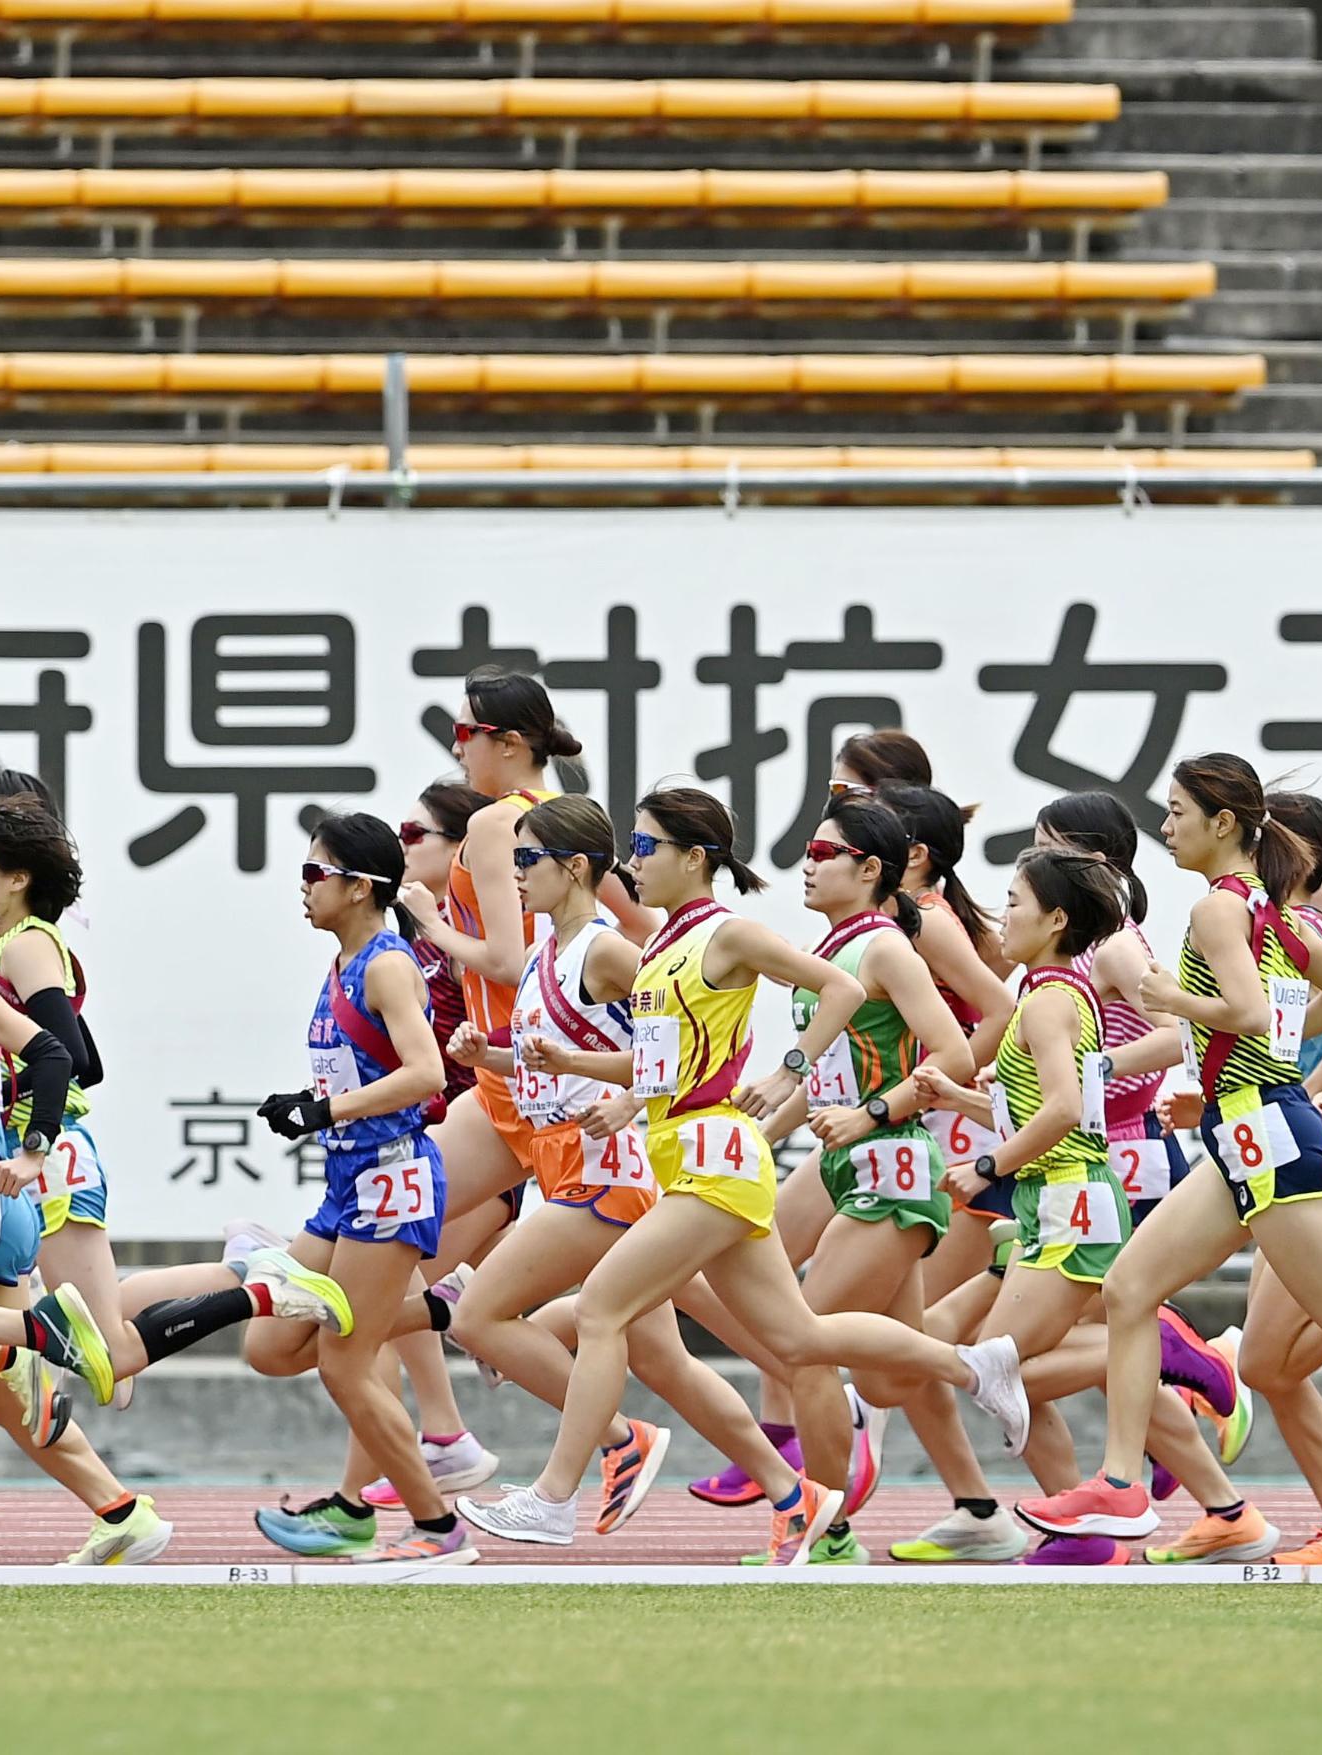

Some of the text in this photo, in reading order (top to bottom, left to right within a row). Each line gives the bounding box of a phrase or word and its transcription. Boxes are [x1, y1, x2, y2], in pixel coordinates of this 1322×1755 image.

[635, 1047, 666, 1083] 4-1
[809, 1063, 846, 1097] 8-1
[599, 1130, 645, 1180] 45
[695, 1122, 745, 1171] 14
[1233, 1122, 1264, 1168] 8
[867, 1146, 916, 1192] 18
[374, 1167, 422, 1218] 25
[1069, 1189, 1092, 1236] 4
[228, 1567, 269, 1583] B-33
[1242, 1566, 1282, 1582] B-32
